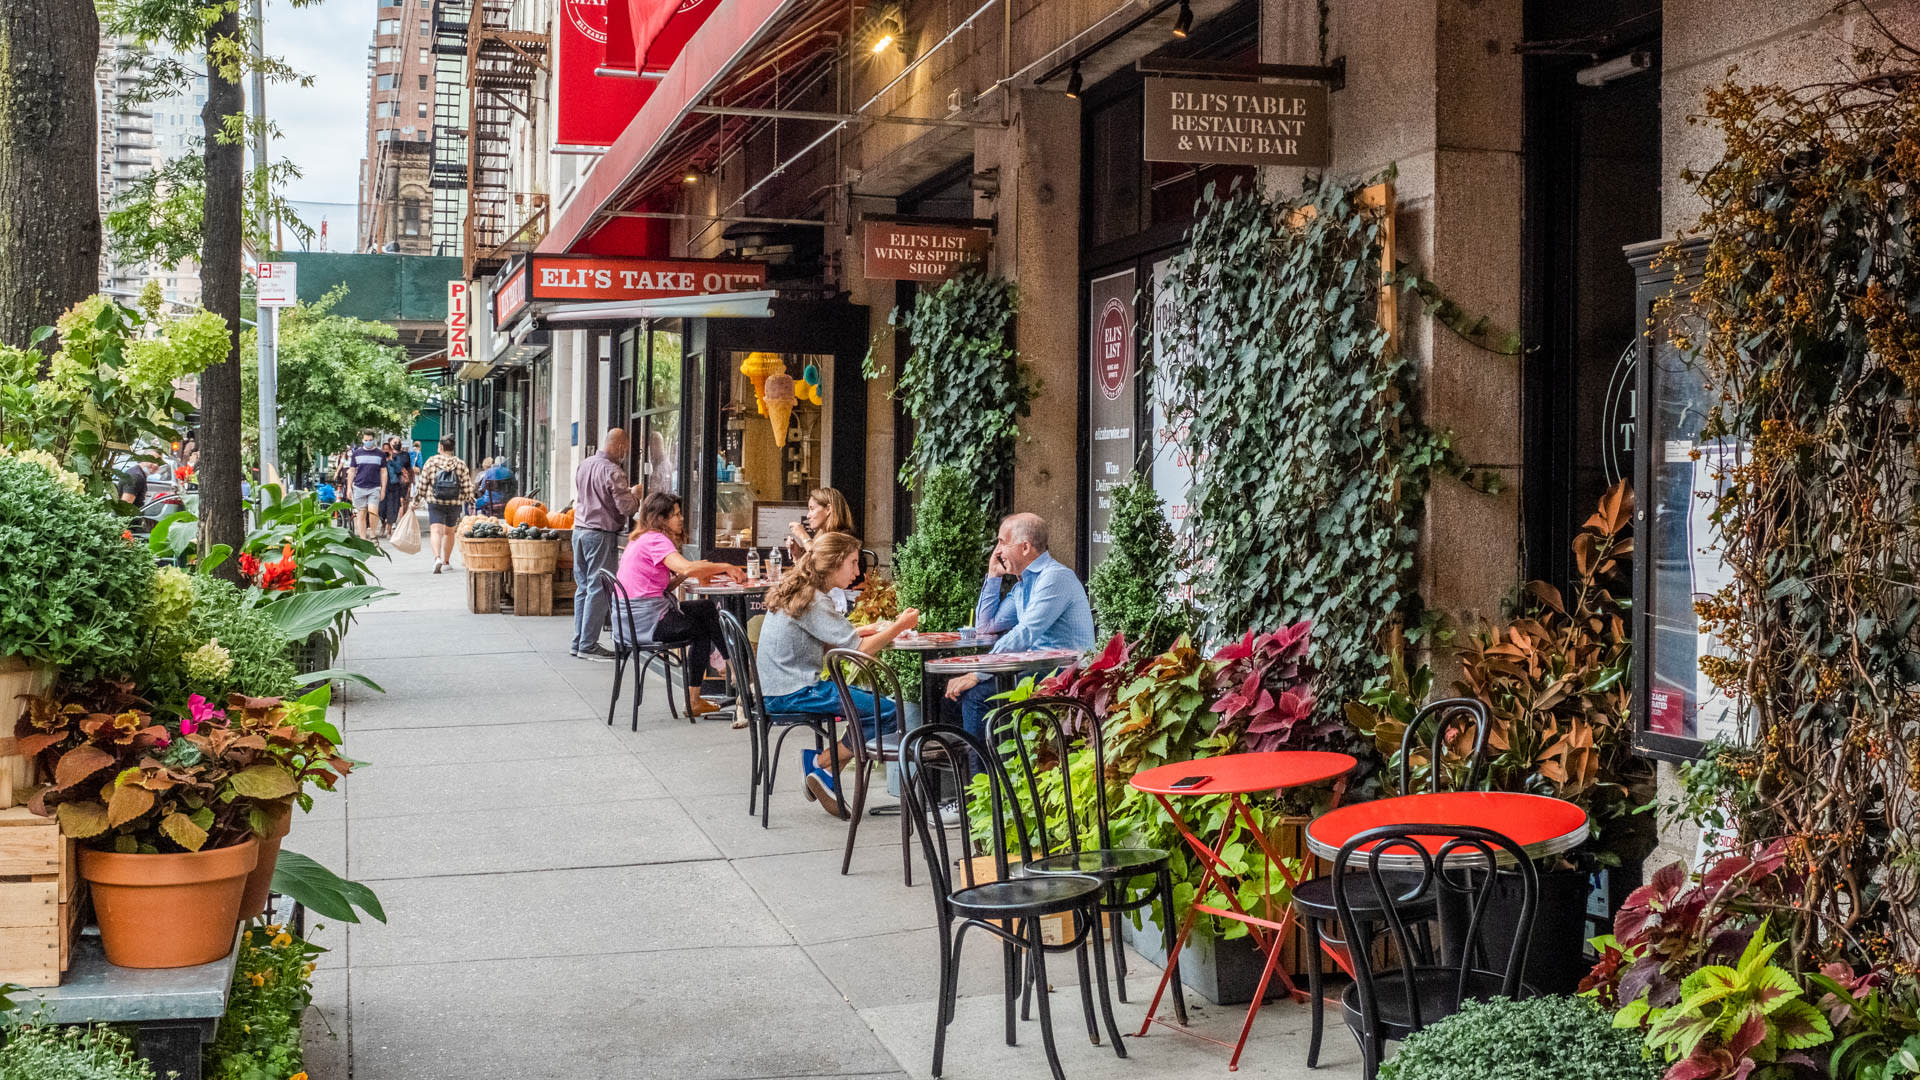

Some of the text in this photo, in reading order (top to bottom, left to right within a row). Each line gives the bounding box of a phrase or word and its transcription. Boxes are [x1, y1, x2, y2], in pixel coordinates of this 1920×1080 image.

[1170, 92, 1307, 116] ELI'S TABLE
[1171, 115, 1306, 136] RESTAURANT
[1178, 135, 1298, 156] & WINE BAR
[890, 233, 967, 249] ELI'S LIST
[874, 247, 978, 263] WINE & SPIRI
[909, 263, 947, 275] SHOP
[540, 267, 612, 289] ELI'S
[620, 270, 695, 291] TAKE
[451, 284, 466, 358] PIZZA
[1105, 342, 1121, 359] LIST
[1105, 461, 1120, 474] Wine
